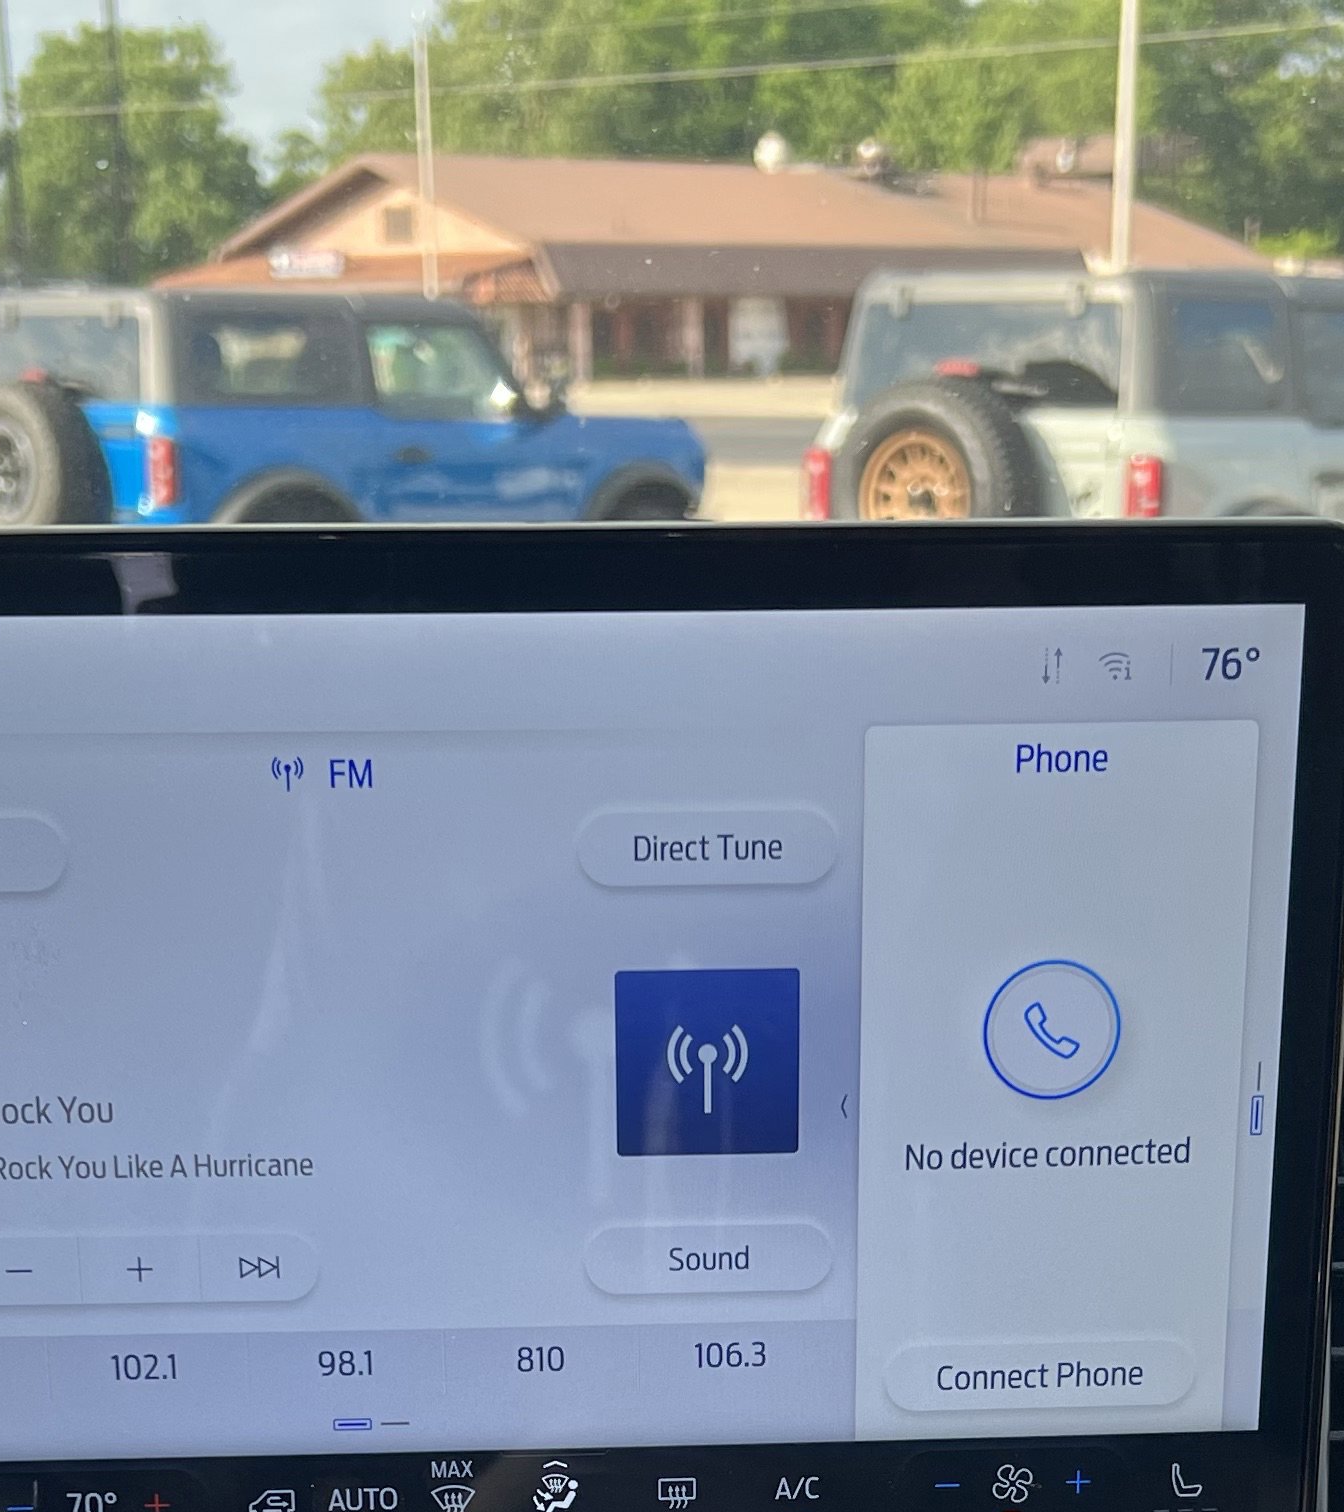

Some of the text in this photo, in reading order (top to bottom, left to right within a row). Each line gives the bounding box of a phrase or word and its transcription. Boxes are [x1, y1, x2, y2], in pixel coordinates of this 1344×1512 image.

[1201, 647, 1260, 681] 76°
[1016, 743, 1108, 774] Phone
[329, 758, 373, 789] FM
[633, 834, 783, 862] Direct Tune
[1, 1095, 53, 1125] ock
[57, 1095, 113, 1124] You
[57, 1155, 107, 1180] You
[113, 1153, 164, 1179] Like
[169, 1154, 188, 1178] A
[193, 1153, 314, 1178] Hurricane
[905, 1135, 1191, 1171] No device connected
[669, 1244, 750, 1272] Sound
[111, 1353, 177, 1381] 102.1
[318, 1349, 373, 1377] 98.1
[517, 1345, 565, 1373] 810
[694, 1341, 766, 1369] 106.3
[937, 1360, 1144, 1391] Connect Phone
[430, 1460, 474, 1479] MAX
[328, 1486, 398, 1512] AUTO
[774, 1476, 820, 1500] A/C
